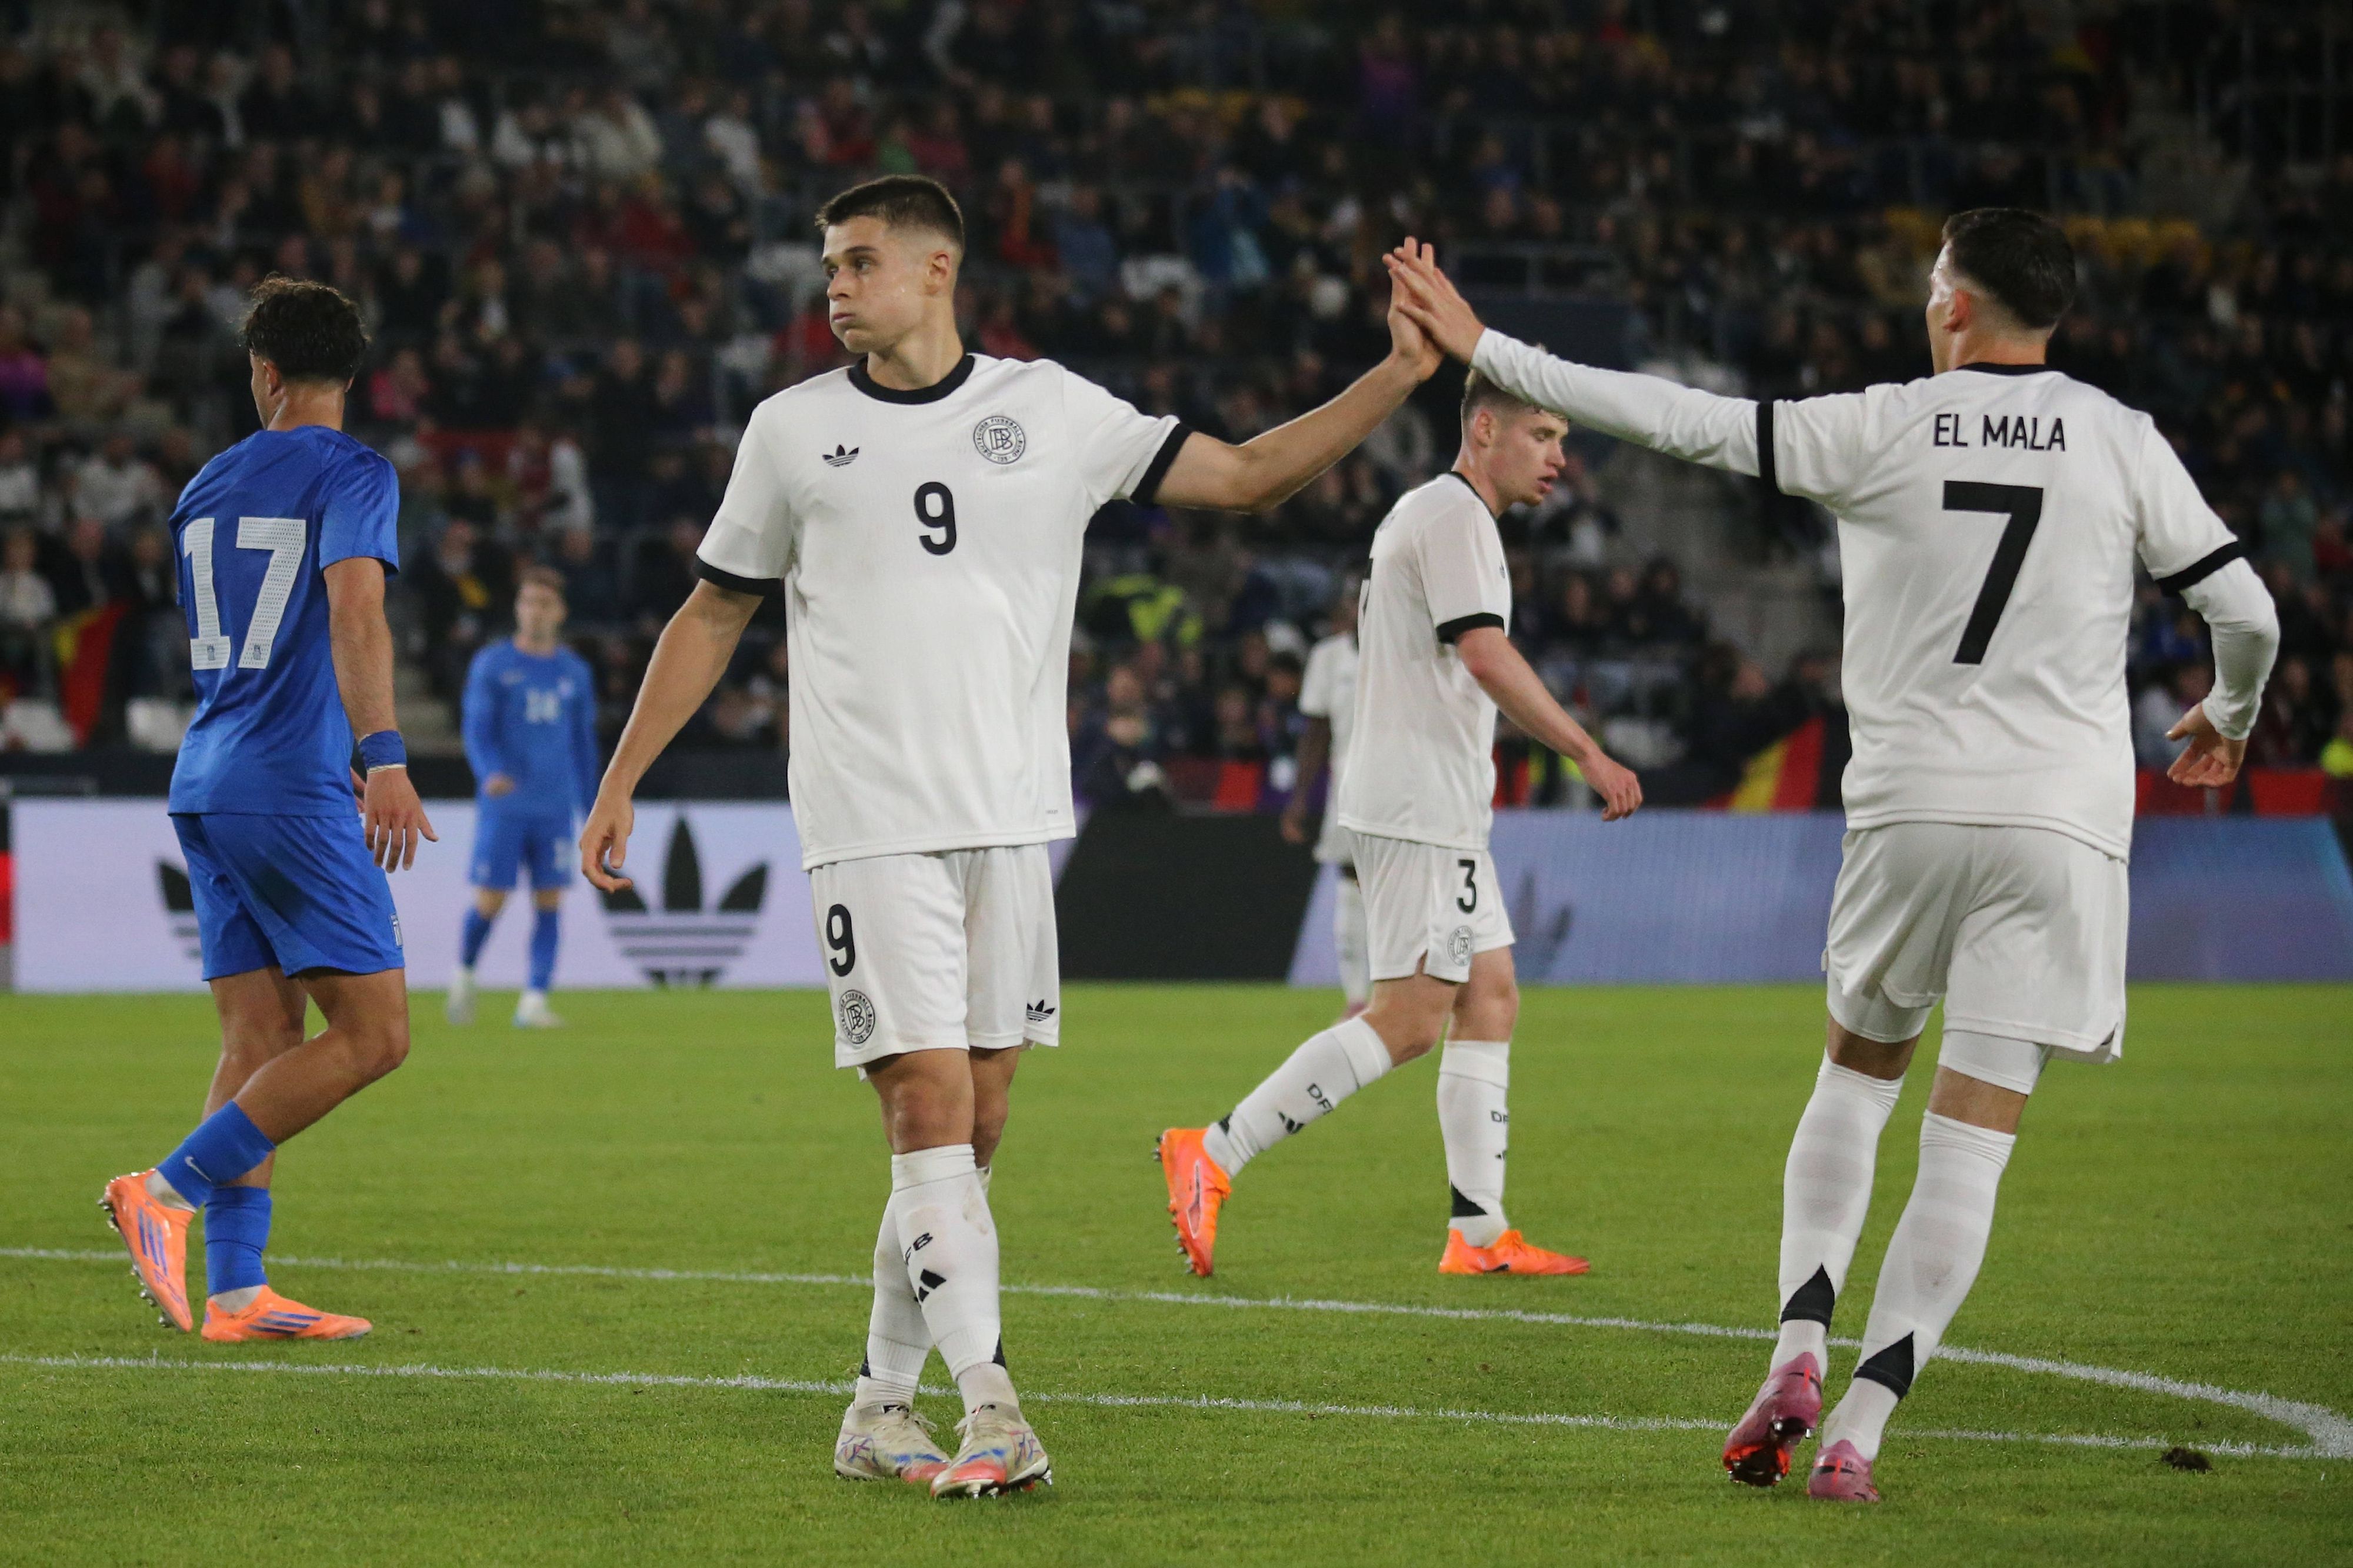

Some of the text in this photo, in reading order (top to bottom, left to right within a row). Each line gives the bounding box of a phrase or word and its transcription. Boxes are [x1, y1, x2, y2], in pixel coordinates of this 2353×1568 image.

[1933, 413, 2067, 451] EL MALA
[913, 481, 957, 556] 9
[184, 516, 307, 671] 17
[1942, 480, 2044, 666] 7
[1456, 859, 1477, 914] 3
[826, 903, 856, 977] 9
[1307, 1082, 1334, 1115] DF
[904, 1232, 934, 1266] FB
